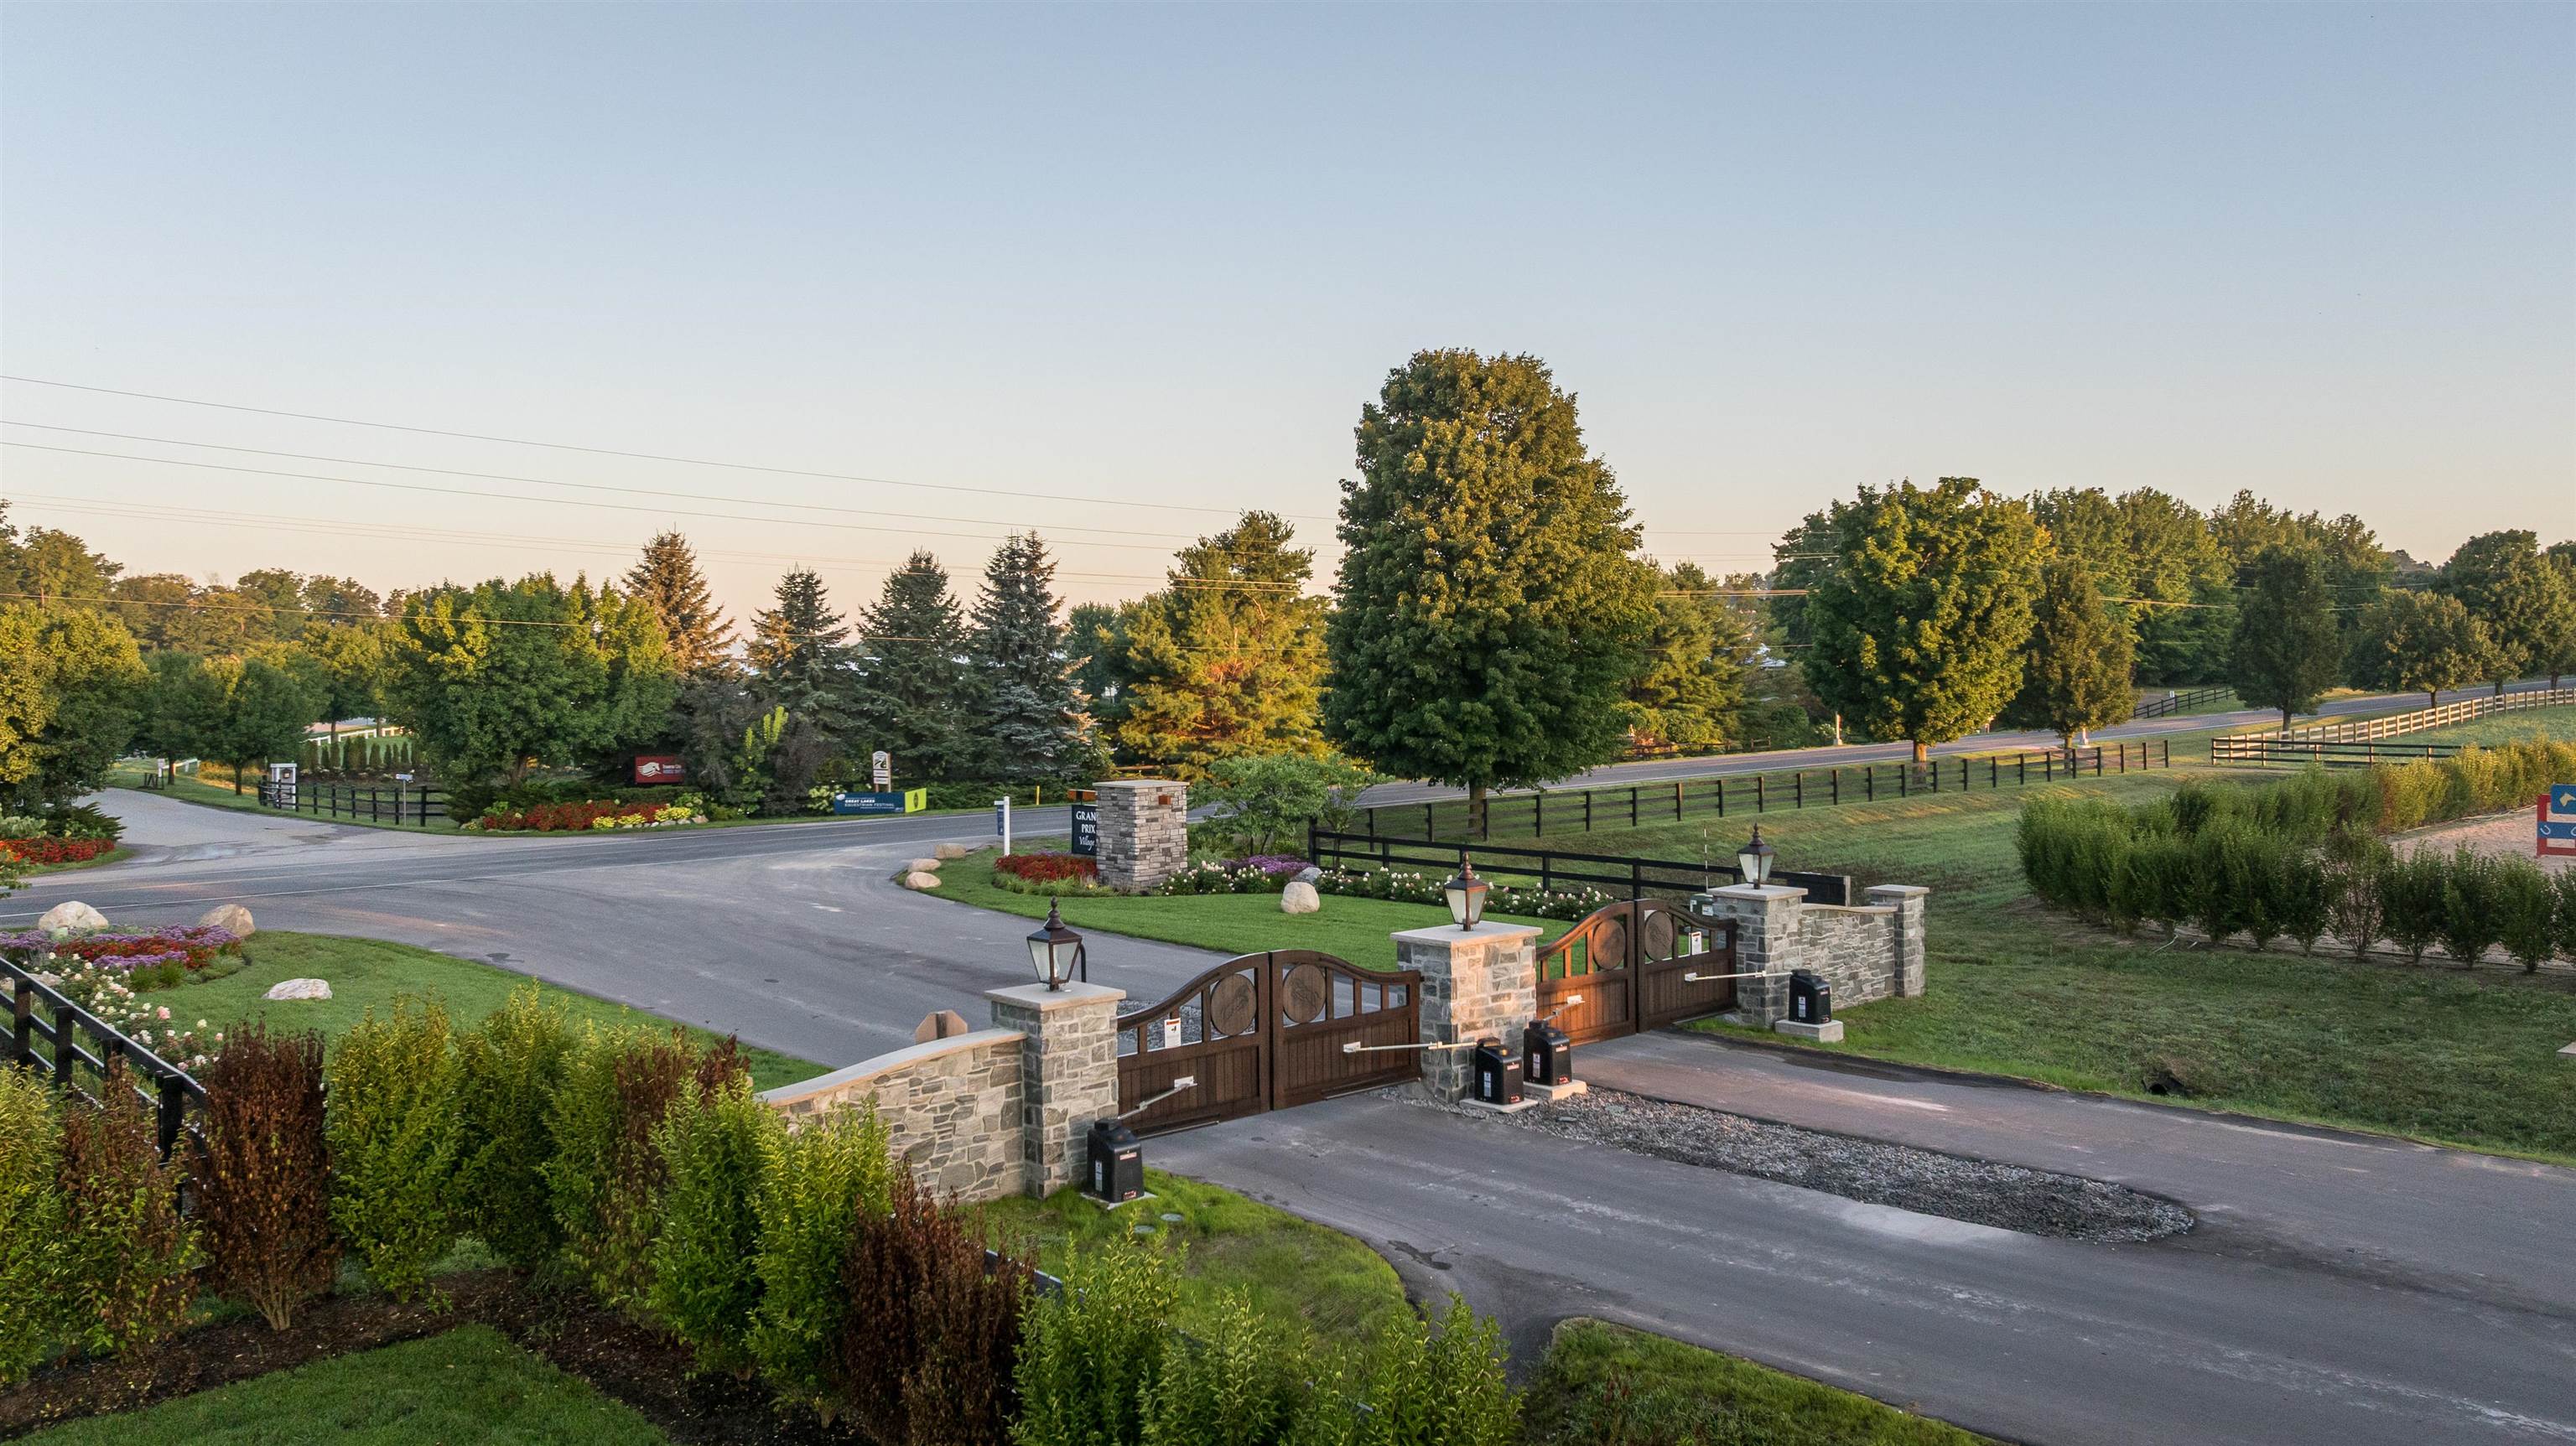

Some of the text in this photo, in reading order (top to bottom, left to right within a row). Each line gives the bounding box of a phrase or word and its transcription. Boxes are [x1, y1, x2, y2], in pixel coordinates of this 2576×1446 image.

[1076, 811, 1097, 821] GRAN
[1081, 824, 1096, 834] PRIX
[1078, 835, 1095, 852] Village
